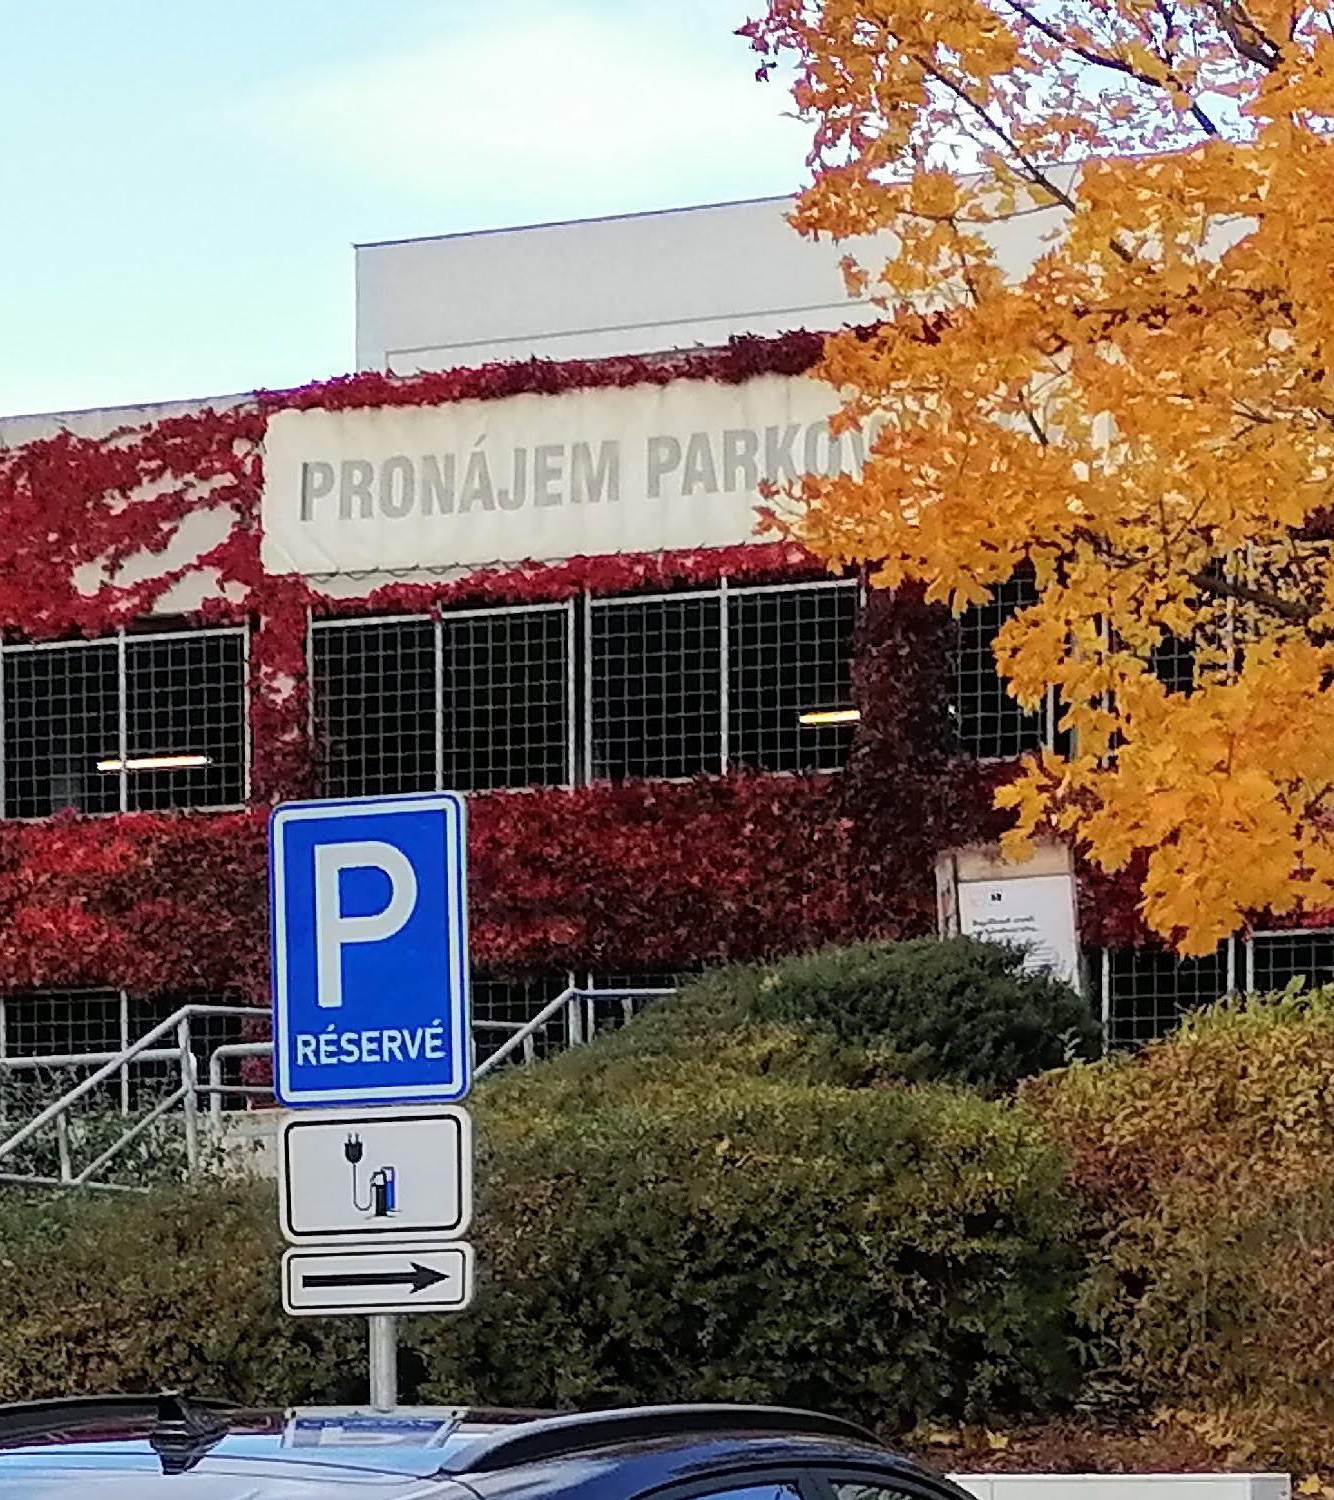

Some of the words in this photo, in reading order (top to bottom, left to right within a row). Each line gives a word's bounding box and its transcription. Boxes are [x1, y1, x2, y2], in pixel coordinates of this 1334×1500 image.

[300, 434, 620, 521] PRONÁJEM
[314, 840, 418, 1009] P
[296, 1018, 446, 1067] RÉSERVÉ
